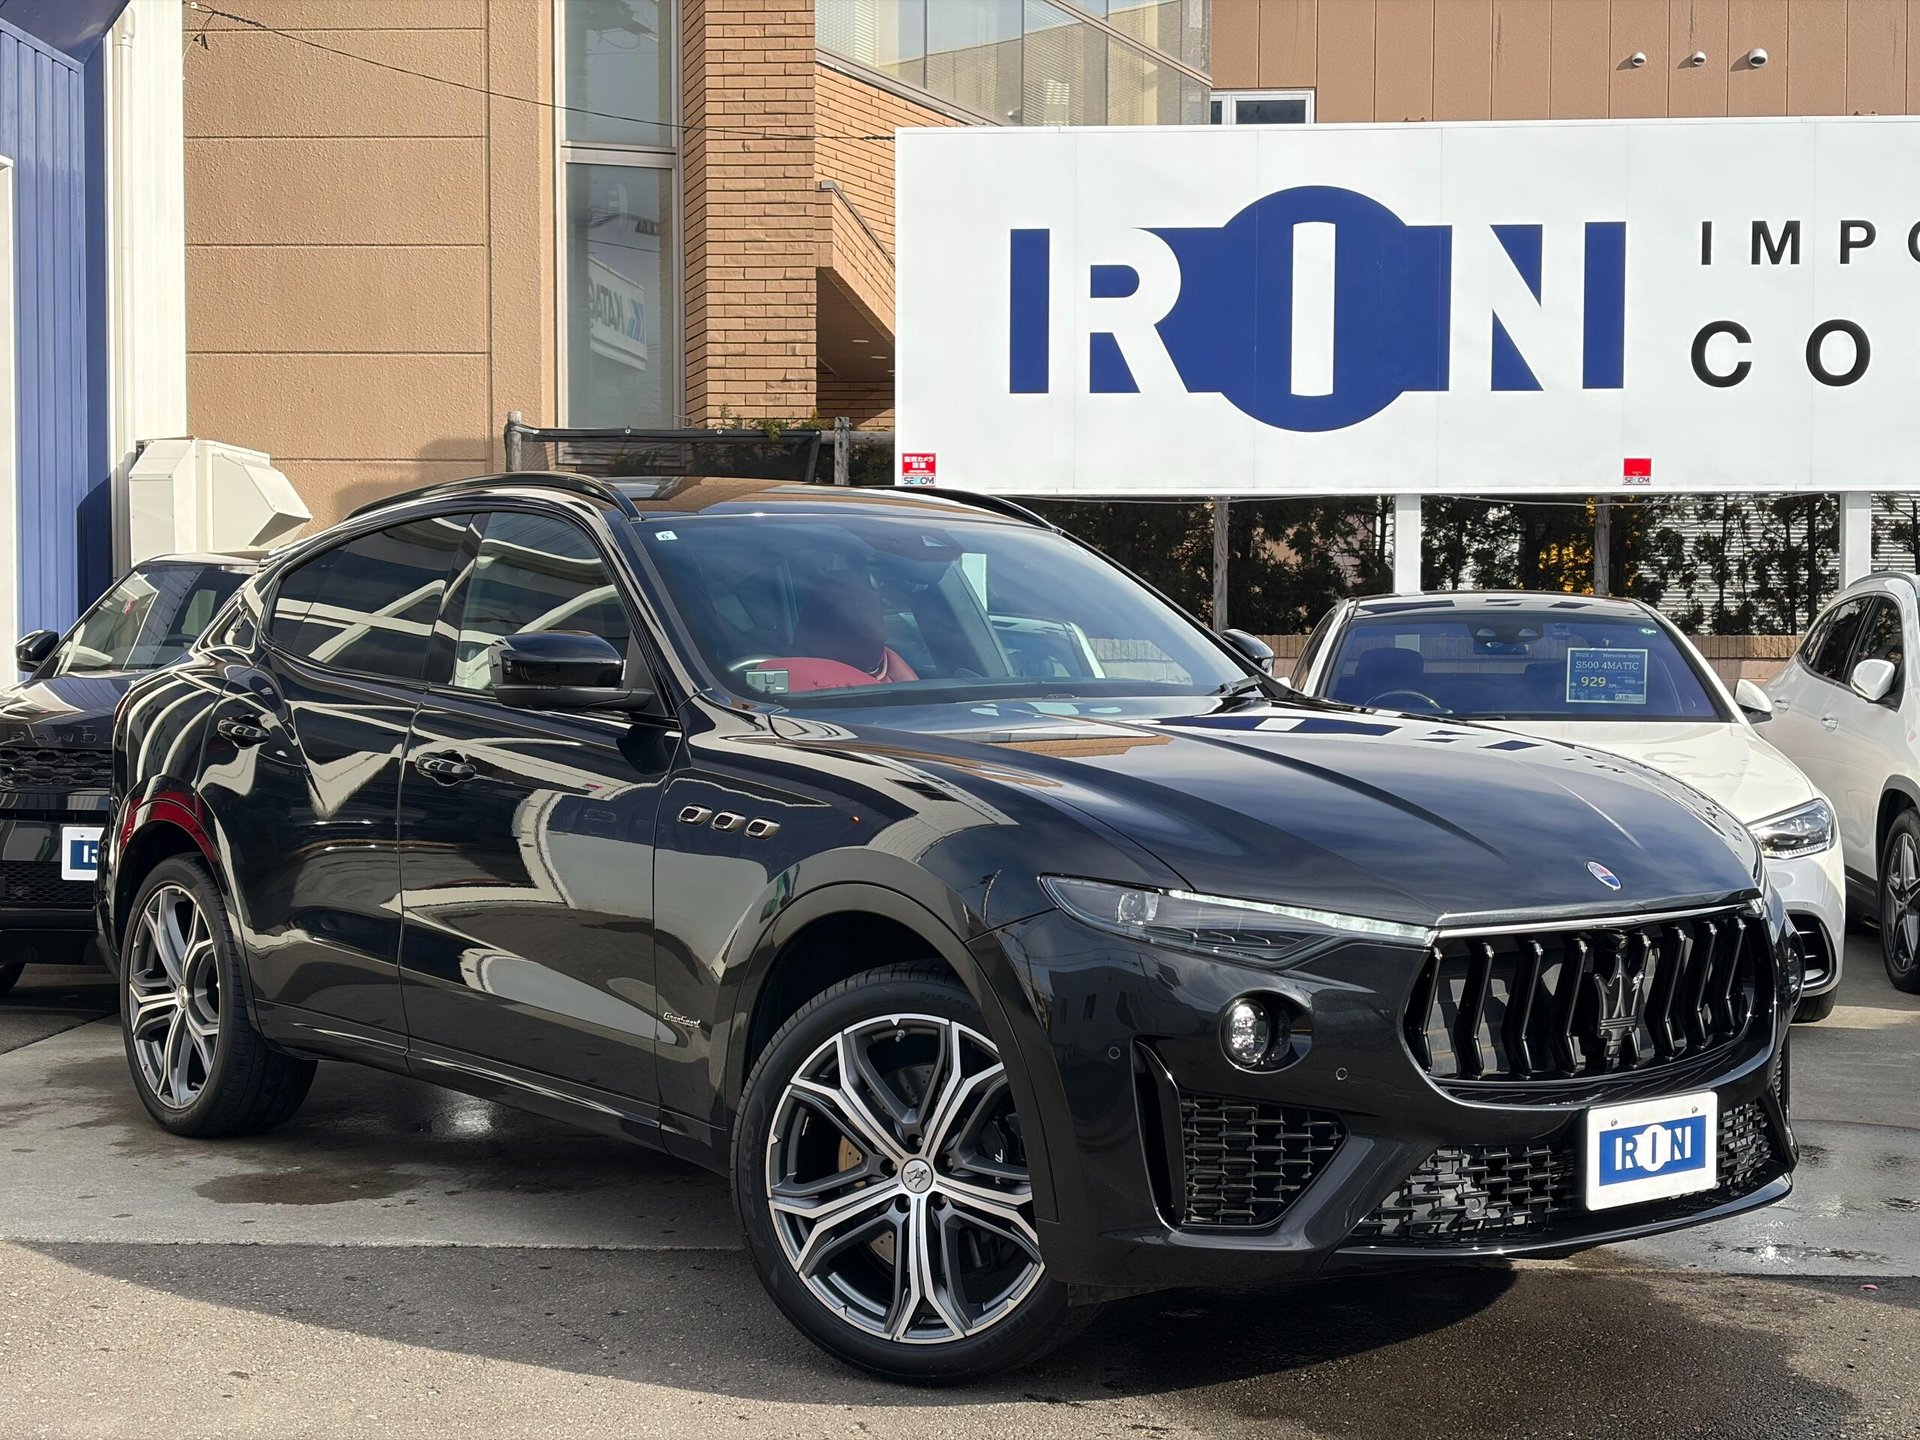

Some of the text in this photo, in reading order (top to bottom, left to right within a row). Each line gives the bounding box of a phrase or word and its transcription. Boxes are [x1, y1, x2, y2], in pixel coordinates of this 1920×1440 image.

[1701, 219, 1920, 266] IMP
[903, 476, 935, 485] SECOM
[1575, 660, 1640, 670] S500 4MATIC
[1580, 676, 1606, 687] 929
